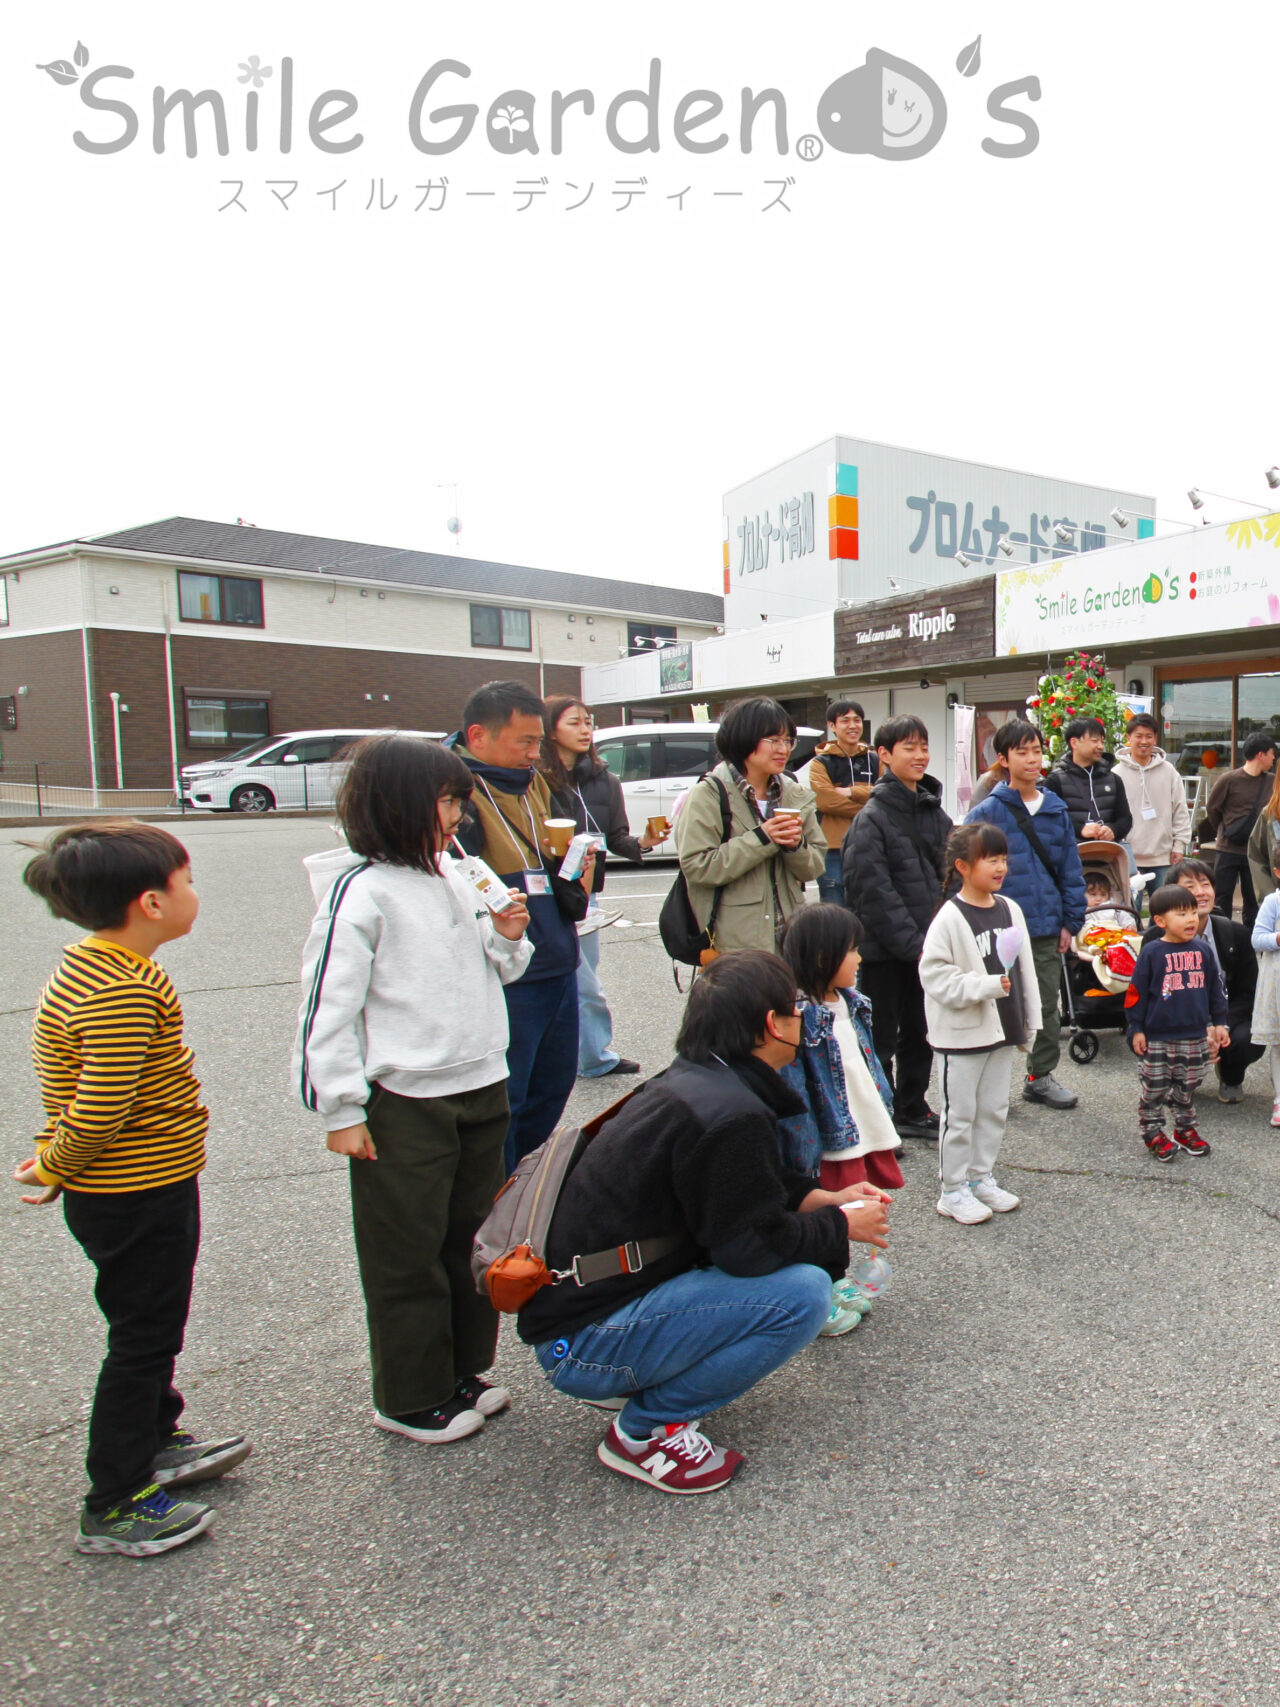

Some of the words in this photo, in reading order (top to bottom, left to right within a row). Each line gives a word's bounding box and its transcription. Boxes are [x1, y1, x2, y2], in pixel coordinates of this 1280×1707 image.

[1038, 592, 1077, 620] Smile
[1083, 582, 1141, 613] Garden
[908, 606, 957, 642] Ripple
[1164, 950, 1204, 973] JUMP
[1187, 971, 1206, 989] JOY
